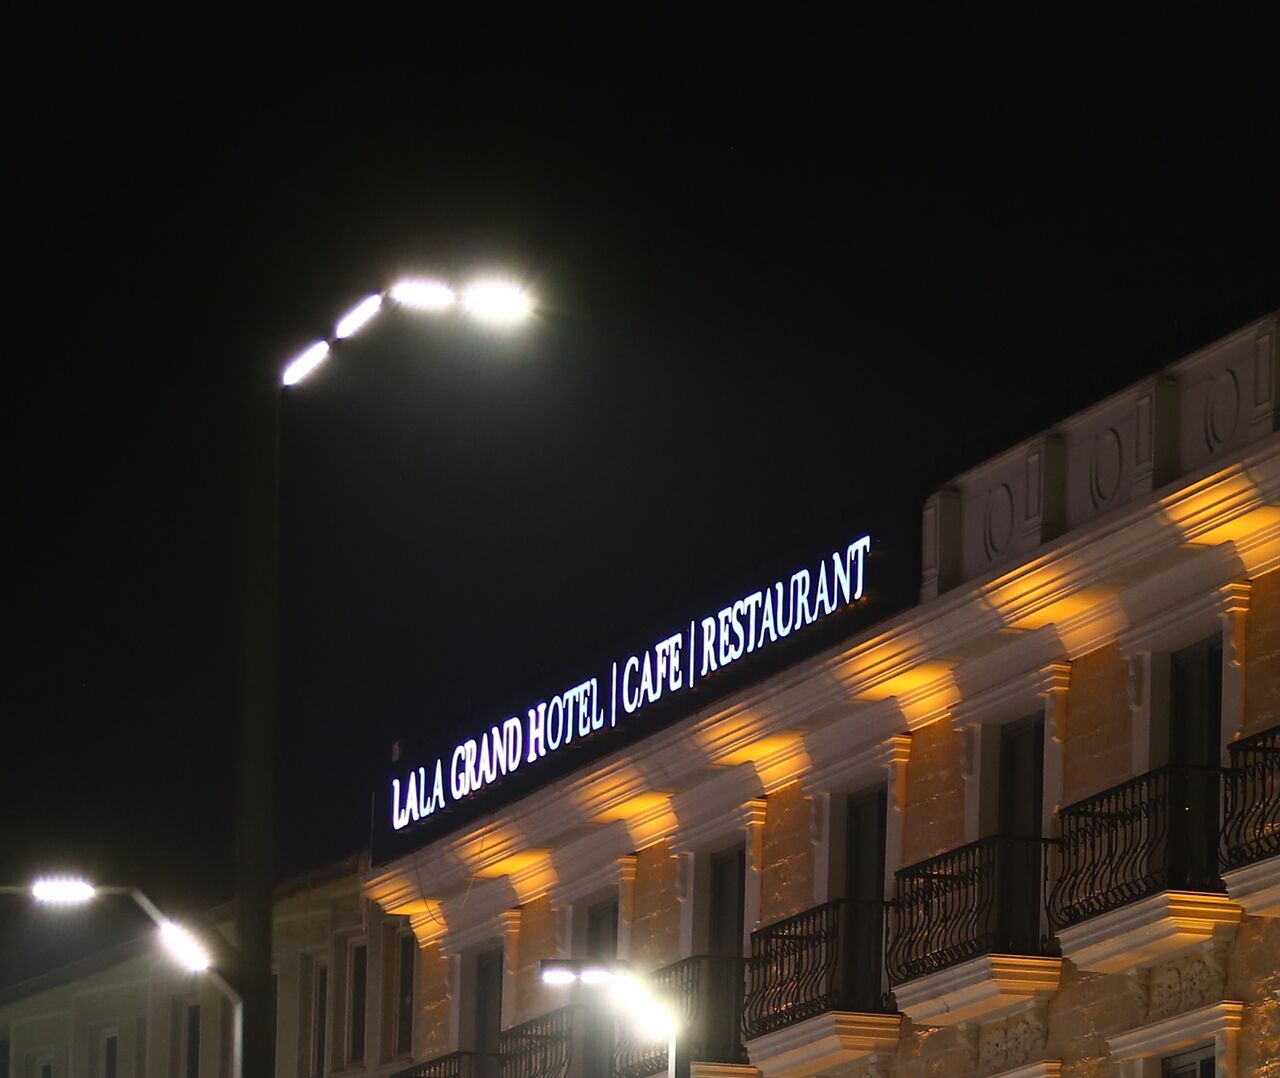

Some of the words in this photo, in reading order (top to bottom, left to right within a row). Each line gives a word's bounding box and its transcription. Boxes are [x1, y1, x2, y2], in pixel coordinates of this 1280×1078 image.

[393, 758, 445, 830] LALA
[450, 717, 523, 801] GRAND
[528, 677, 604, 763] HOTEL
[622, 633, 683, 714] CAFE
[701, 536, 871, 677] RESTAURANT
